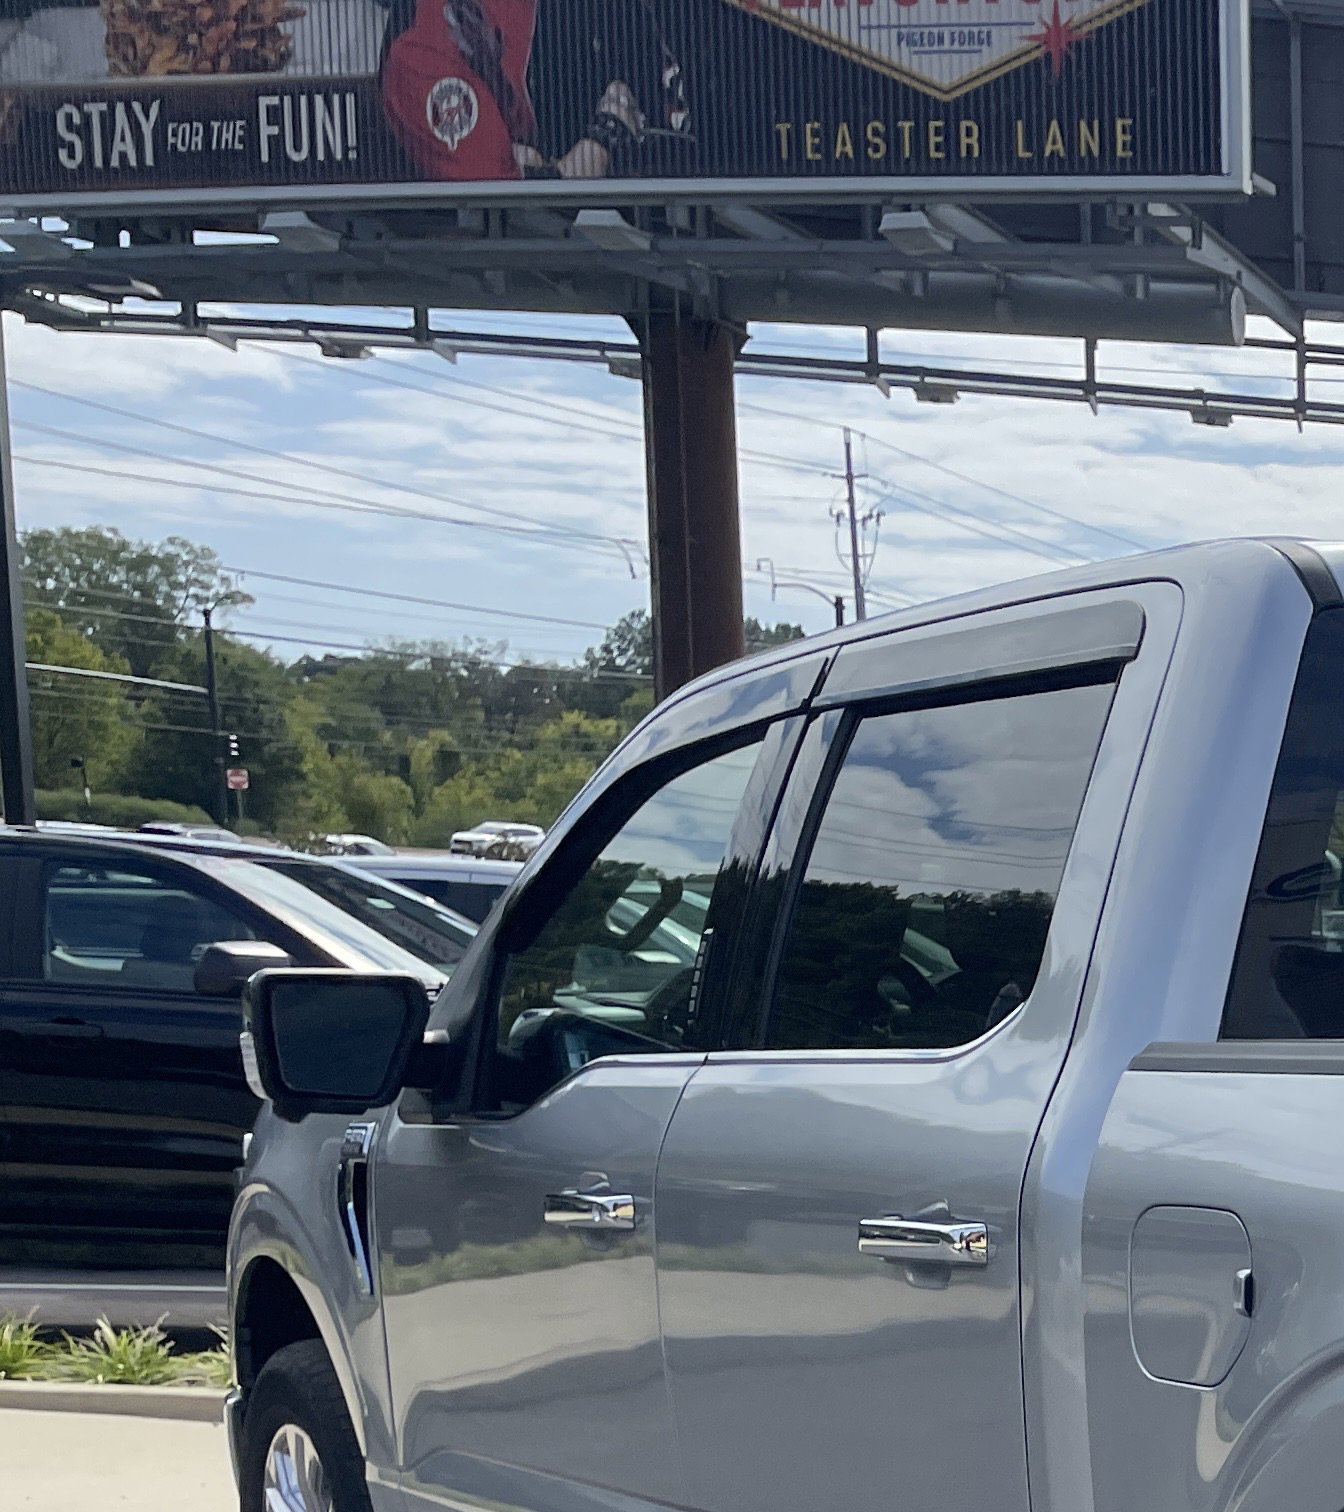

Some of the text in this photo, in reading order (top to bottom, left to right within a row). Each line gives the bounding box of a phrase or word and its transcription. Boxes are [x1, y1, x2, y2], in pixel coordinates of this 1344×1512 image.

[896, 30, 993, 48] PIGEON FORGE
[56, 92, 358, 170] STAY FOR THE FUN!
[775, 117, 1135, 161] TEASTER LANE
